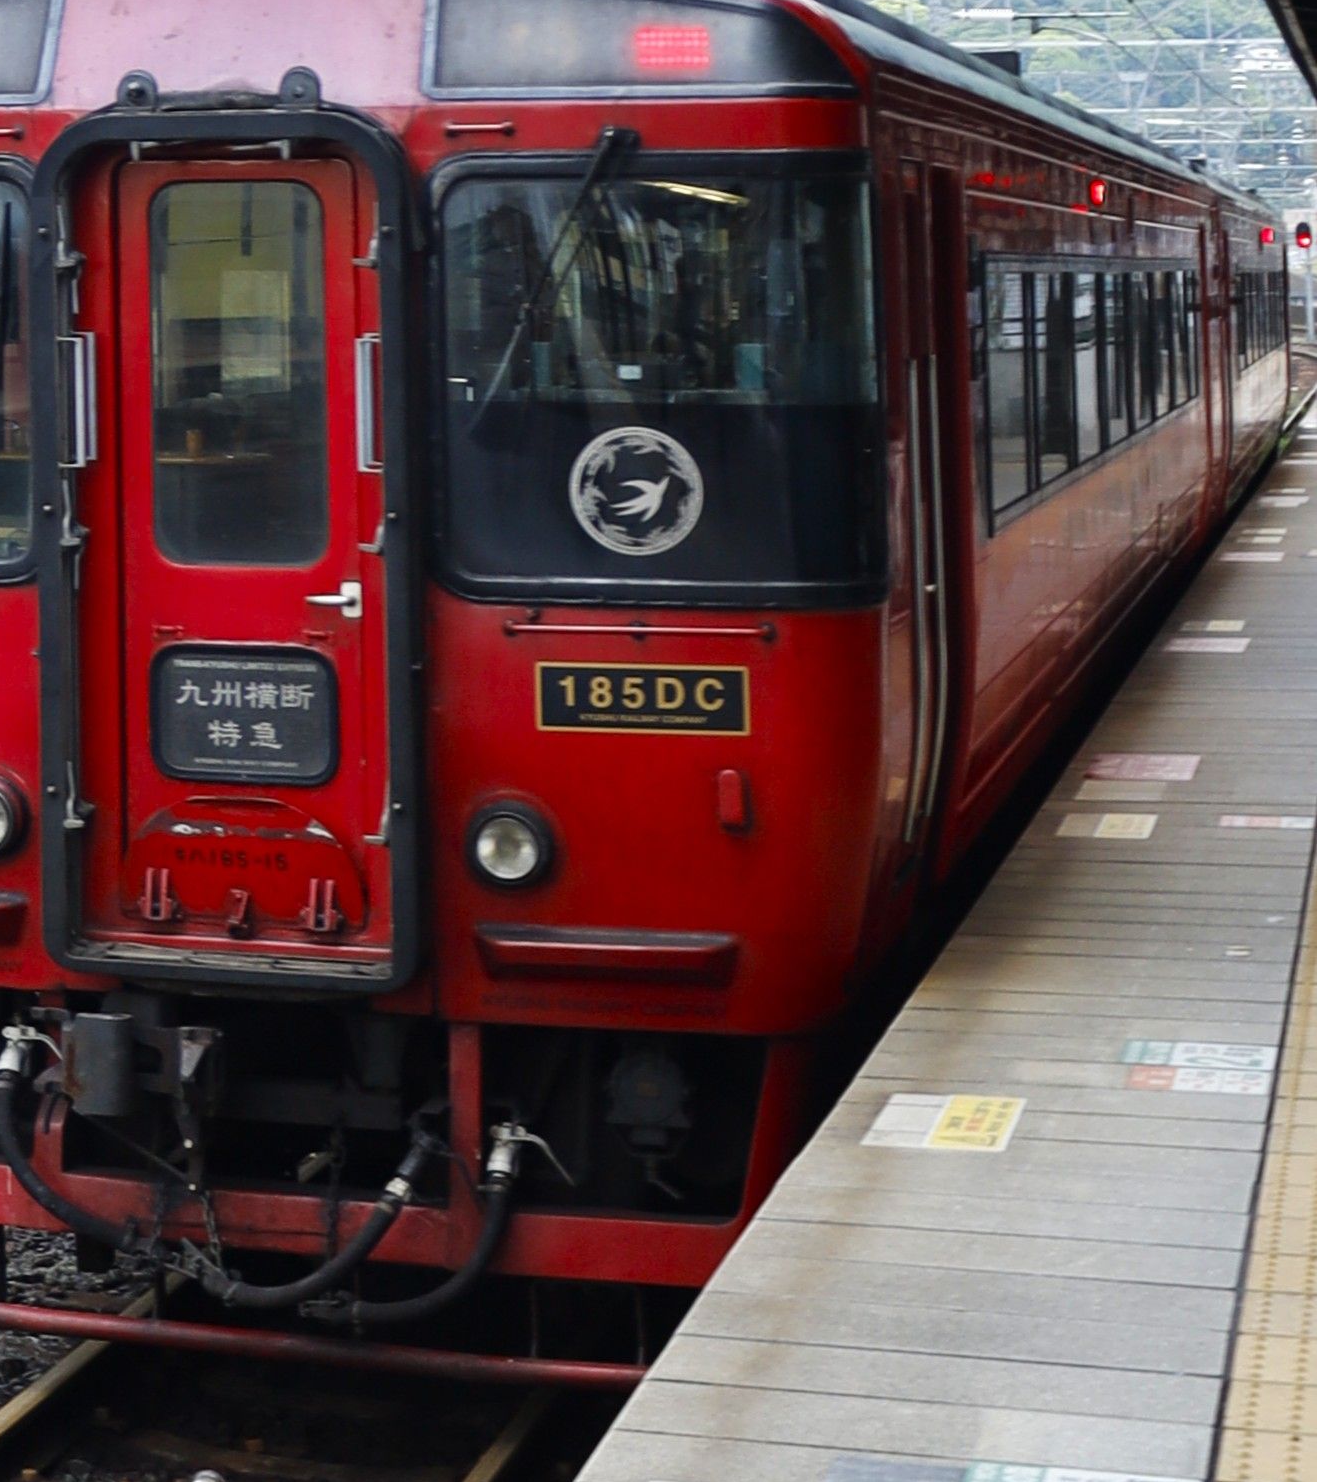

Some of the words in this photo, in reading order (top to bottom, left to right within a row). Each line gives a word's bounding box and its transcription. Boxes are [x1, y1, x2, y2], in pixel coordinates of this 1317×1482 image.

[175, 678, 315, 710] 九州横断
[558, 675, 726, 712] 185DC
[207, 719, 283, 750] 特急
